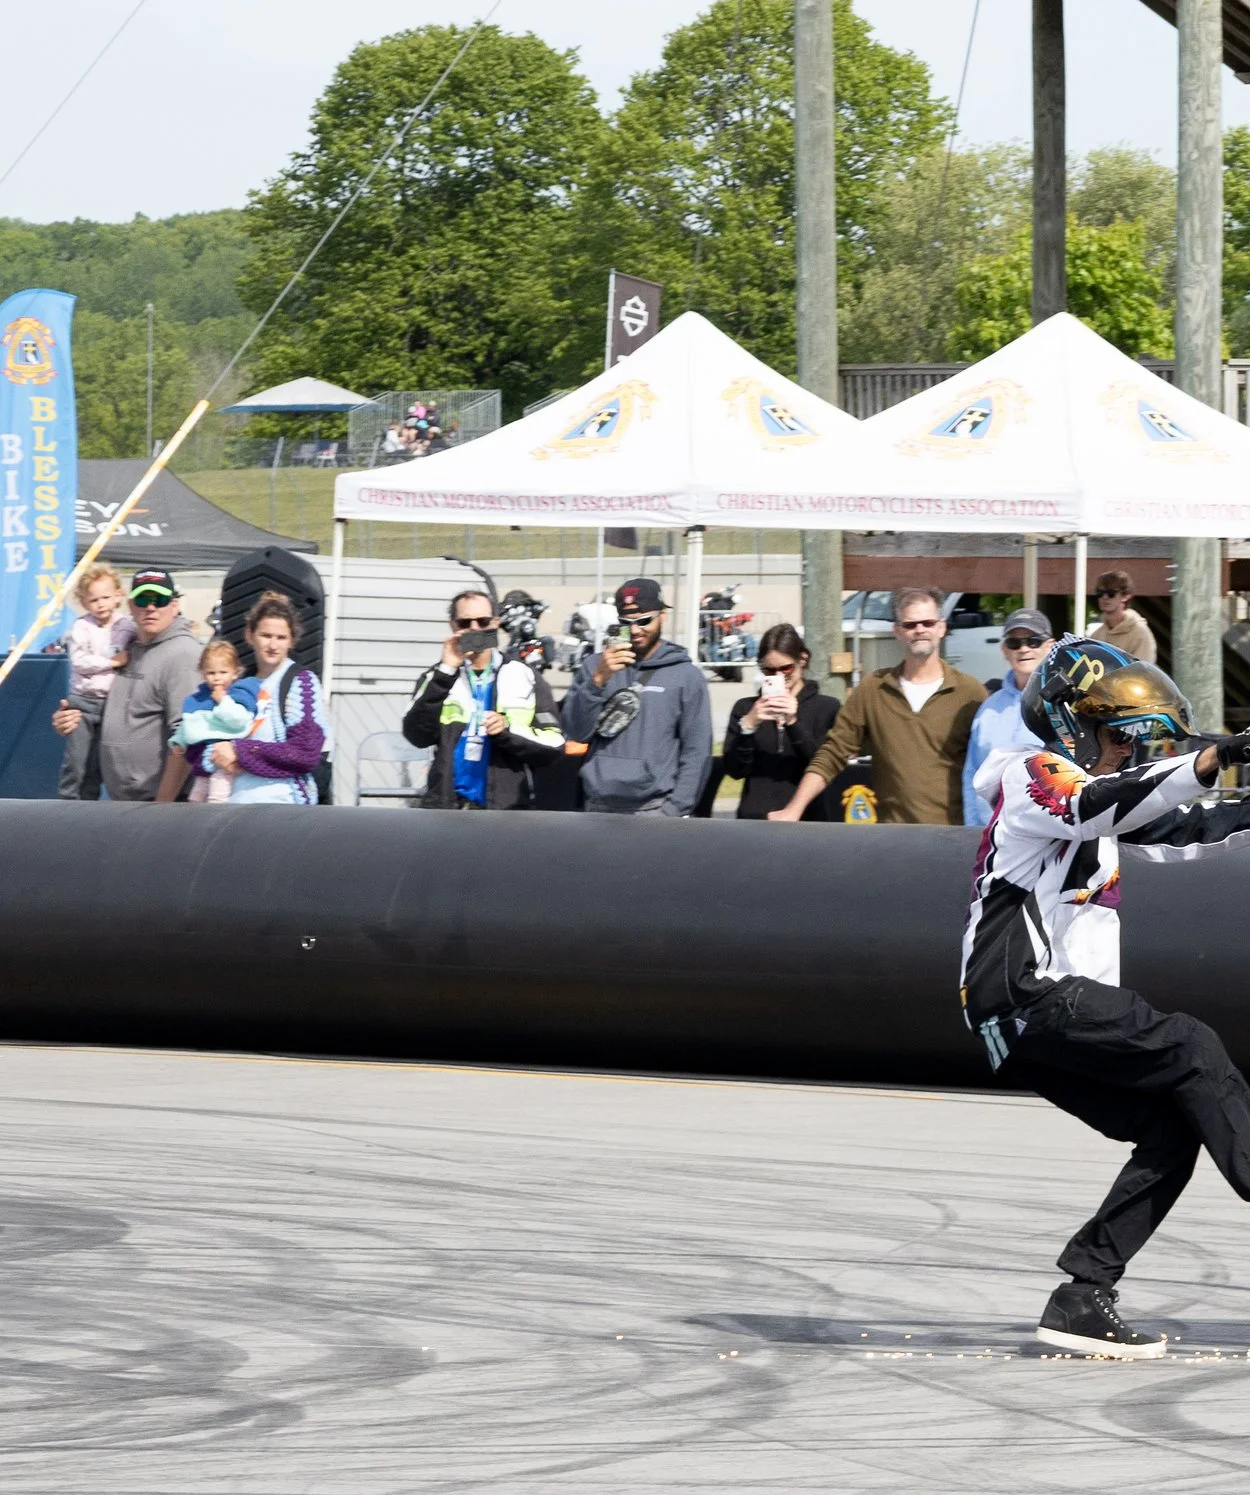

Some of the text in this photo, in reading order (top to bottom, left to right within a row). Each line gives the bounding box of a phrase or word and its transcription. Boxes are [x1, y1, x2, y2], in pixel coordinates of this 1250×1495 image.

[0, 433, 30, 573] BIKE
[75, 499, 121, 518] EY
[358, 487, 673, 512] CHRISTIAN MOTORCYCLISTS ASSOCIATION
[716, 493, 1061, 517] CHRISTIAN MOTORCYCLISTS ASSOCIATION
[75, 519, 163, 537] SON
